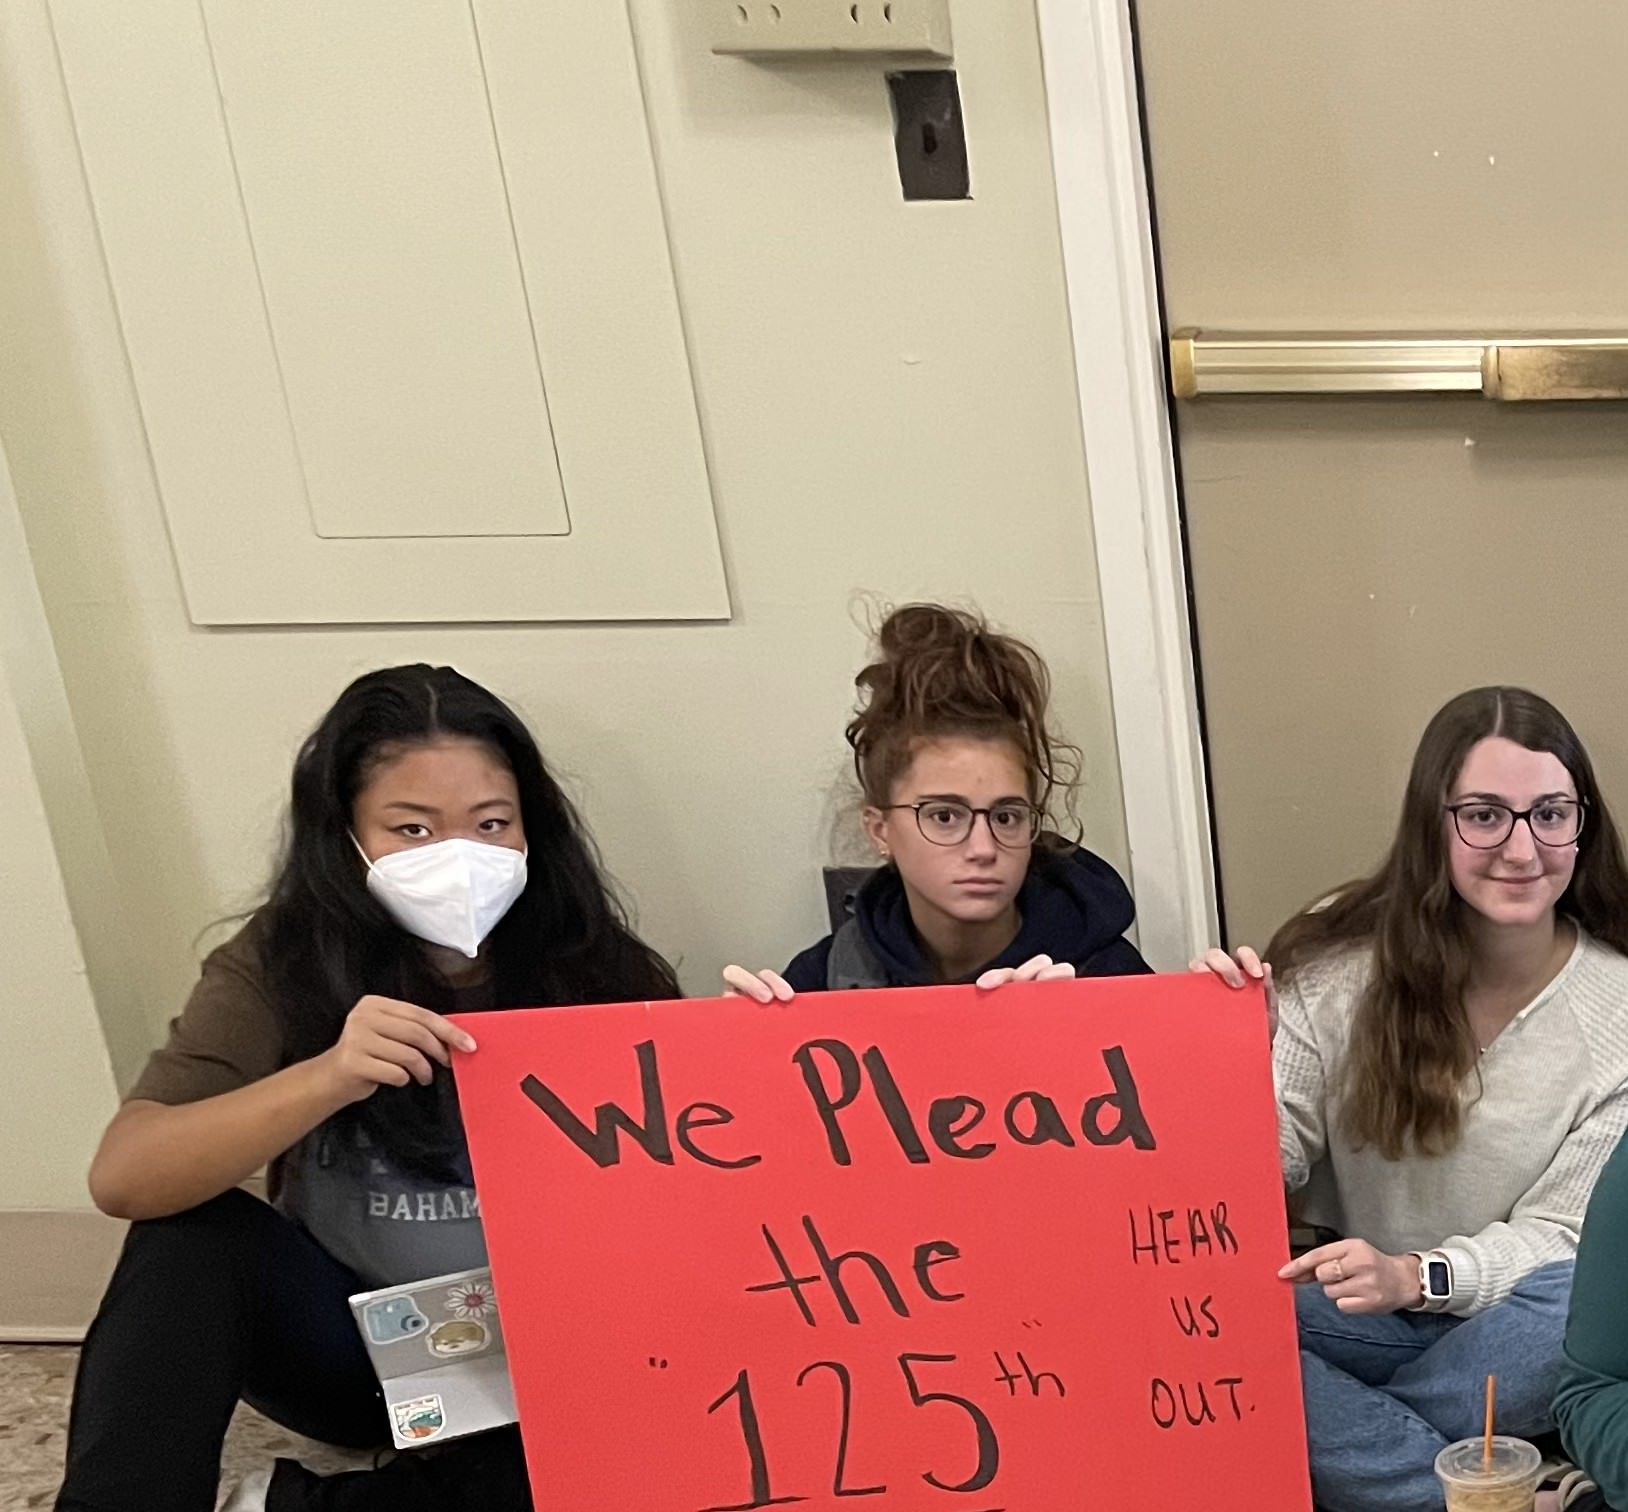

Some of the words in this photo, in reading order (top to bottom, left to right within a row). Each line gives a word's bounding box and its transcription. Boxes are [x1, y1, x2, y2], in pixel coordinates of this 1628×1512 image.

[519, 1039, 762, 1170] We
[793, 1038, 1157, 1167] Plead
[745, 1215, 965, 1327] the
[1128, 1201, 1239, 1265] HEAR
